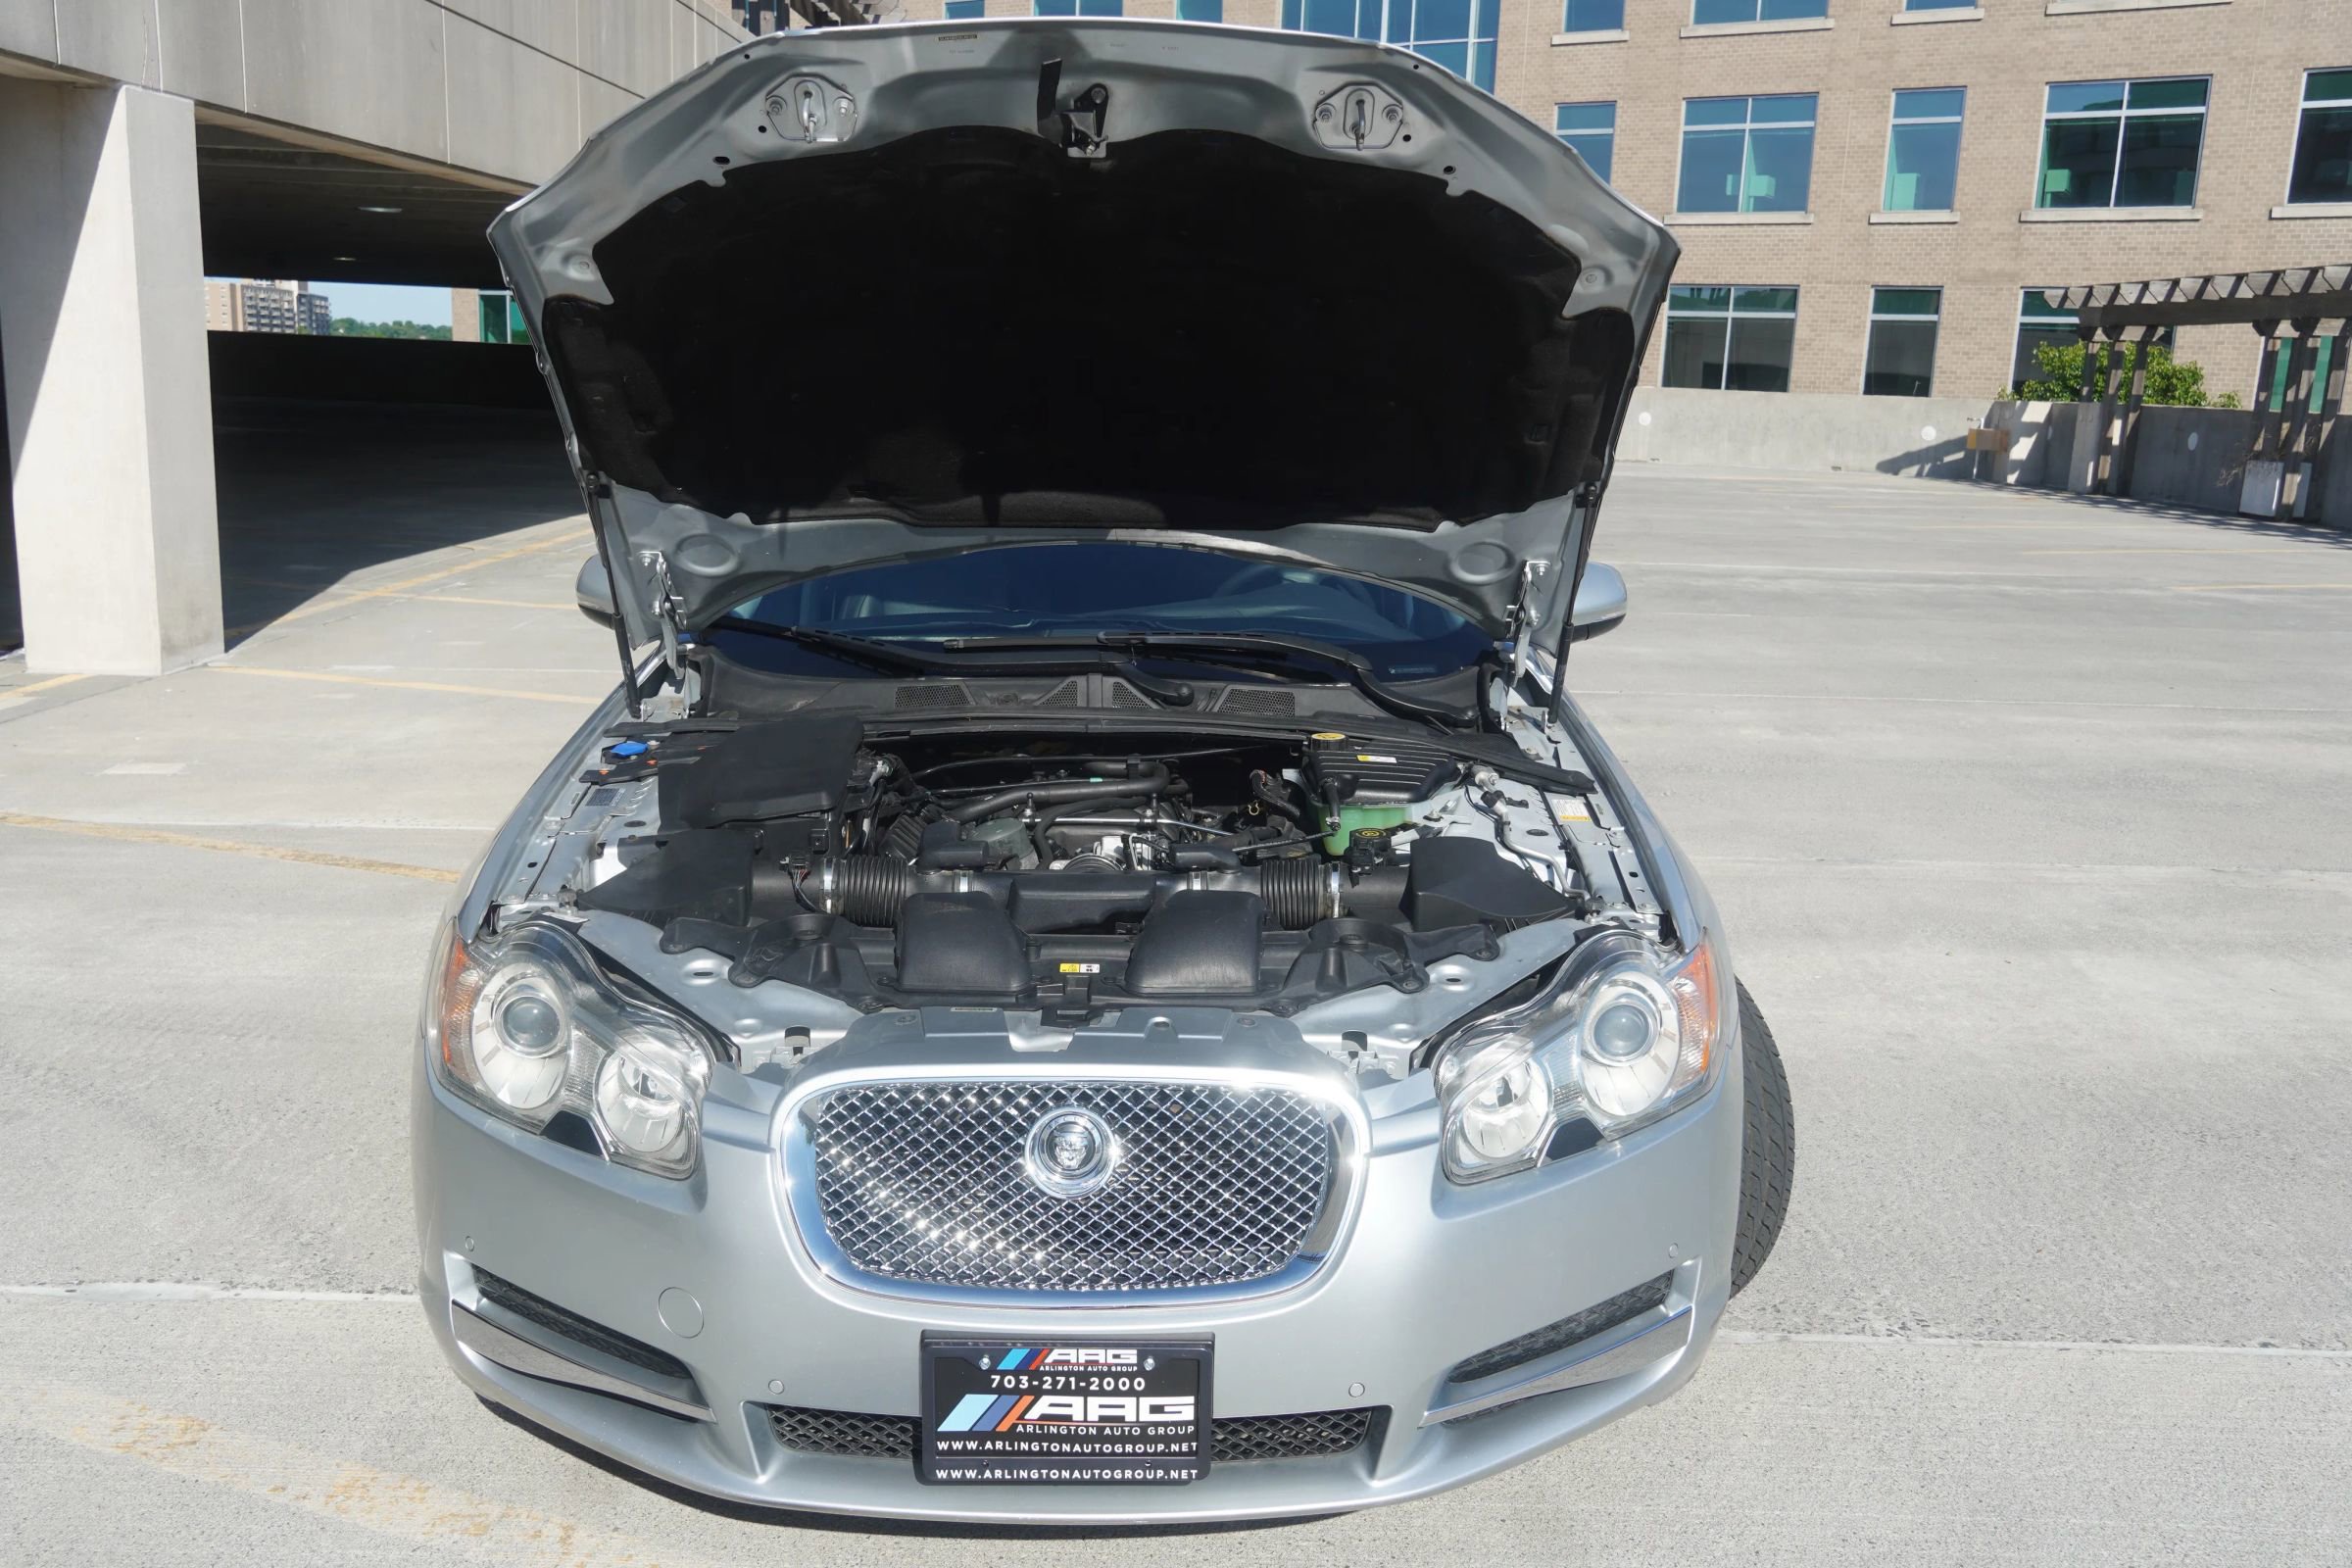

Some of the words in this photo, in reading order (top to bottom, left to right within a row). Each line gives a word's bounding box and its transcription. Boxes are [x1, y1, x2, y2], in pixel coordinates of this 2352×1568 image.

[1044, 1348, 1137, 1364] AAG
[990, 1375, 1146, 1391] 703-271-2000
[1023, 1395, 1195, 1422] AAG
[1016, 1424, 1098, 1435] ARLINGTON
[1103, 1426, 1141, 1436] AUTO
[1147, 1425, 1195, 1436] GROUP
[936, 1441, 1198, 1453] WWW.ARLINGTONAUTOGROUP.NET
[935, 1469, 1198, 1480] WWW.ARLINGTONAUTOGROUP.NET
